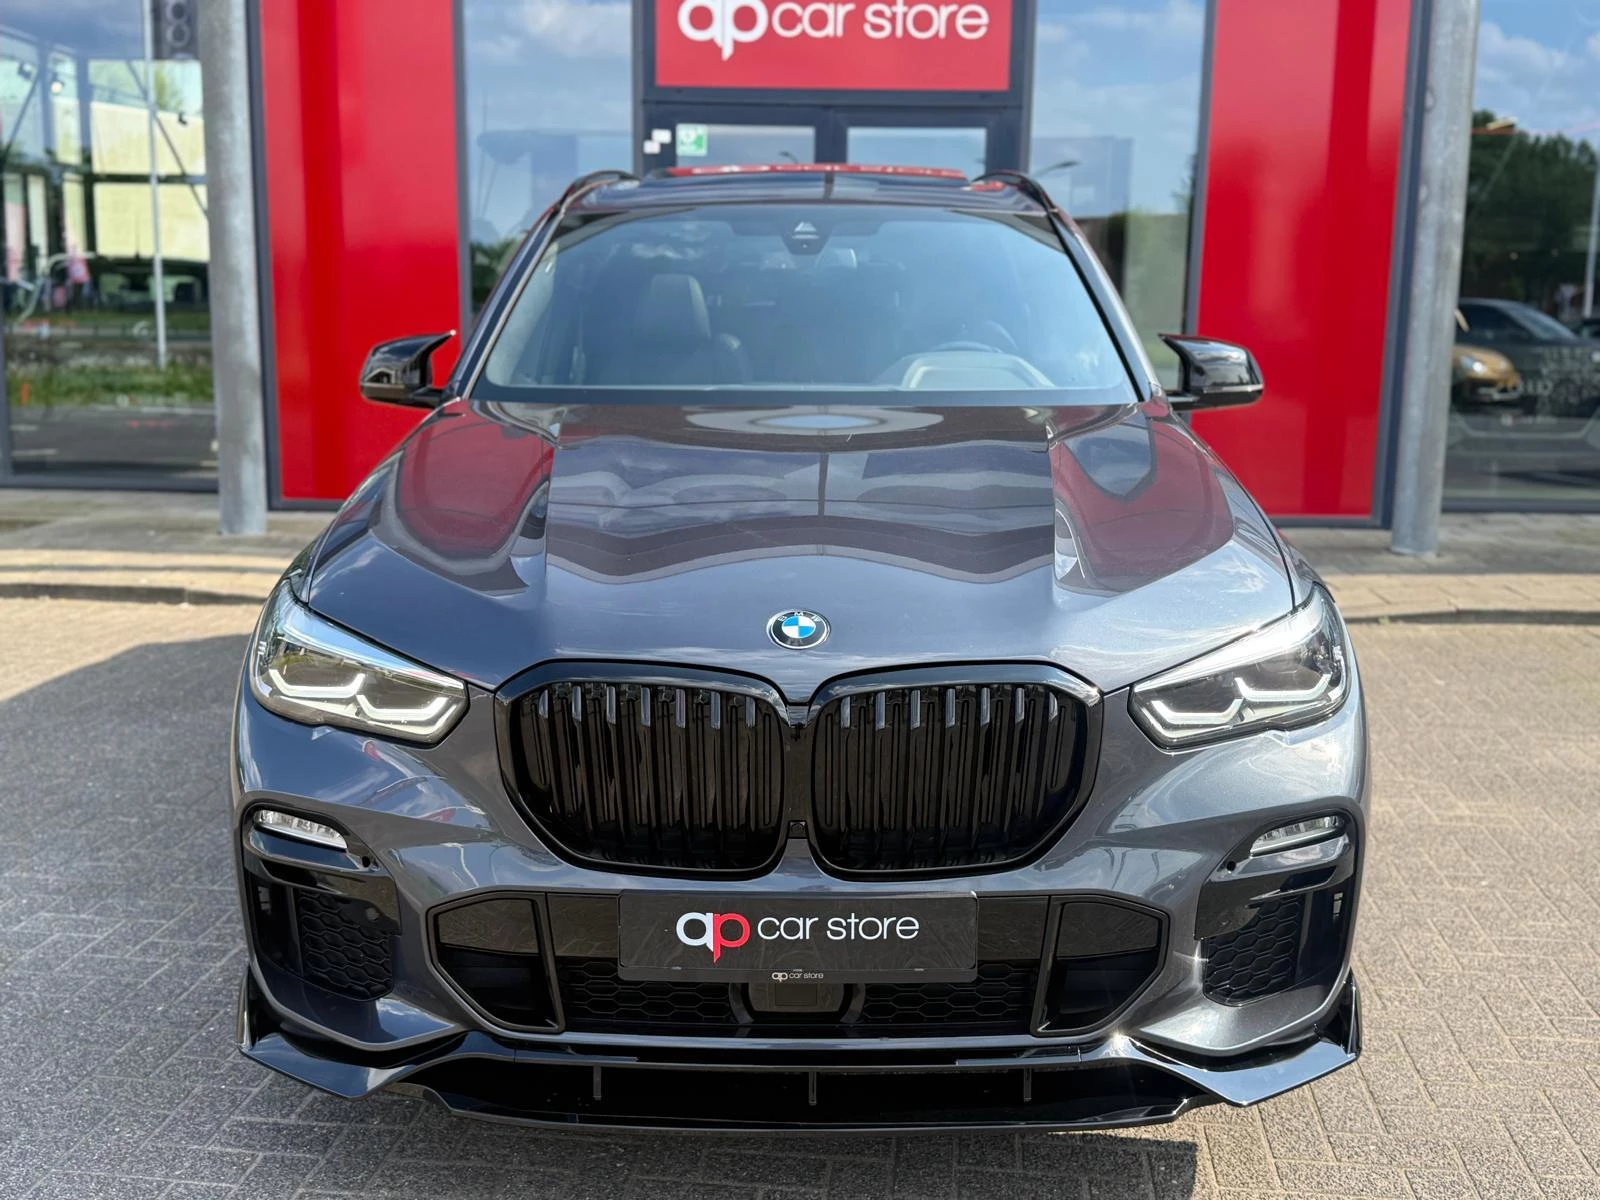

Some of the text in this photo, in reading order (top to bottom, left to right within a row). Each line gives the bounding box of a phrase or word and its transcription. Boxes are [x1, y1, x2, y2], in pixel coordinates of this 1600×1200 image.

[772, 2, 856, 38] car
[863, 0, 989, 40] store
[757, 915, 819, 941] car
[826, 911, 920, 941] store
